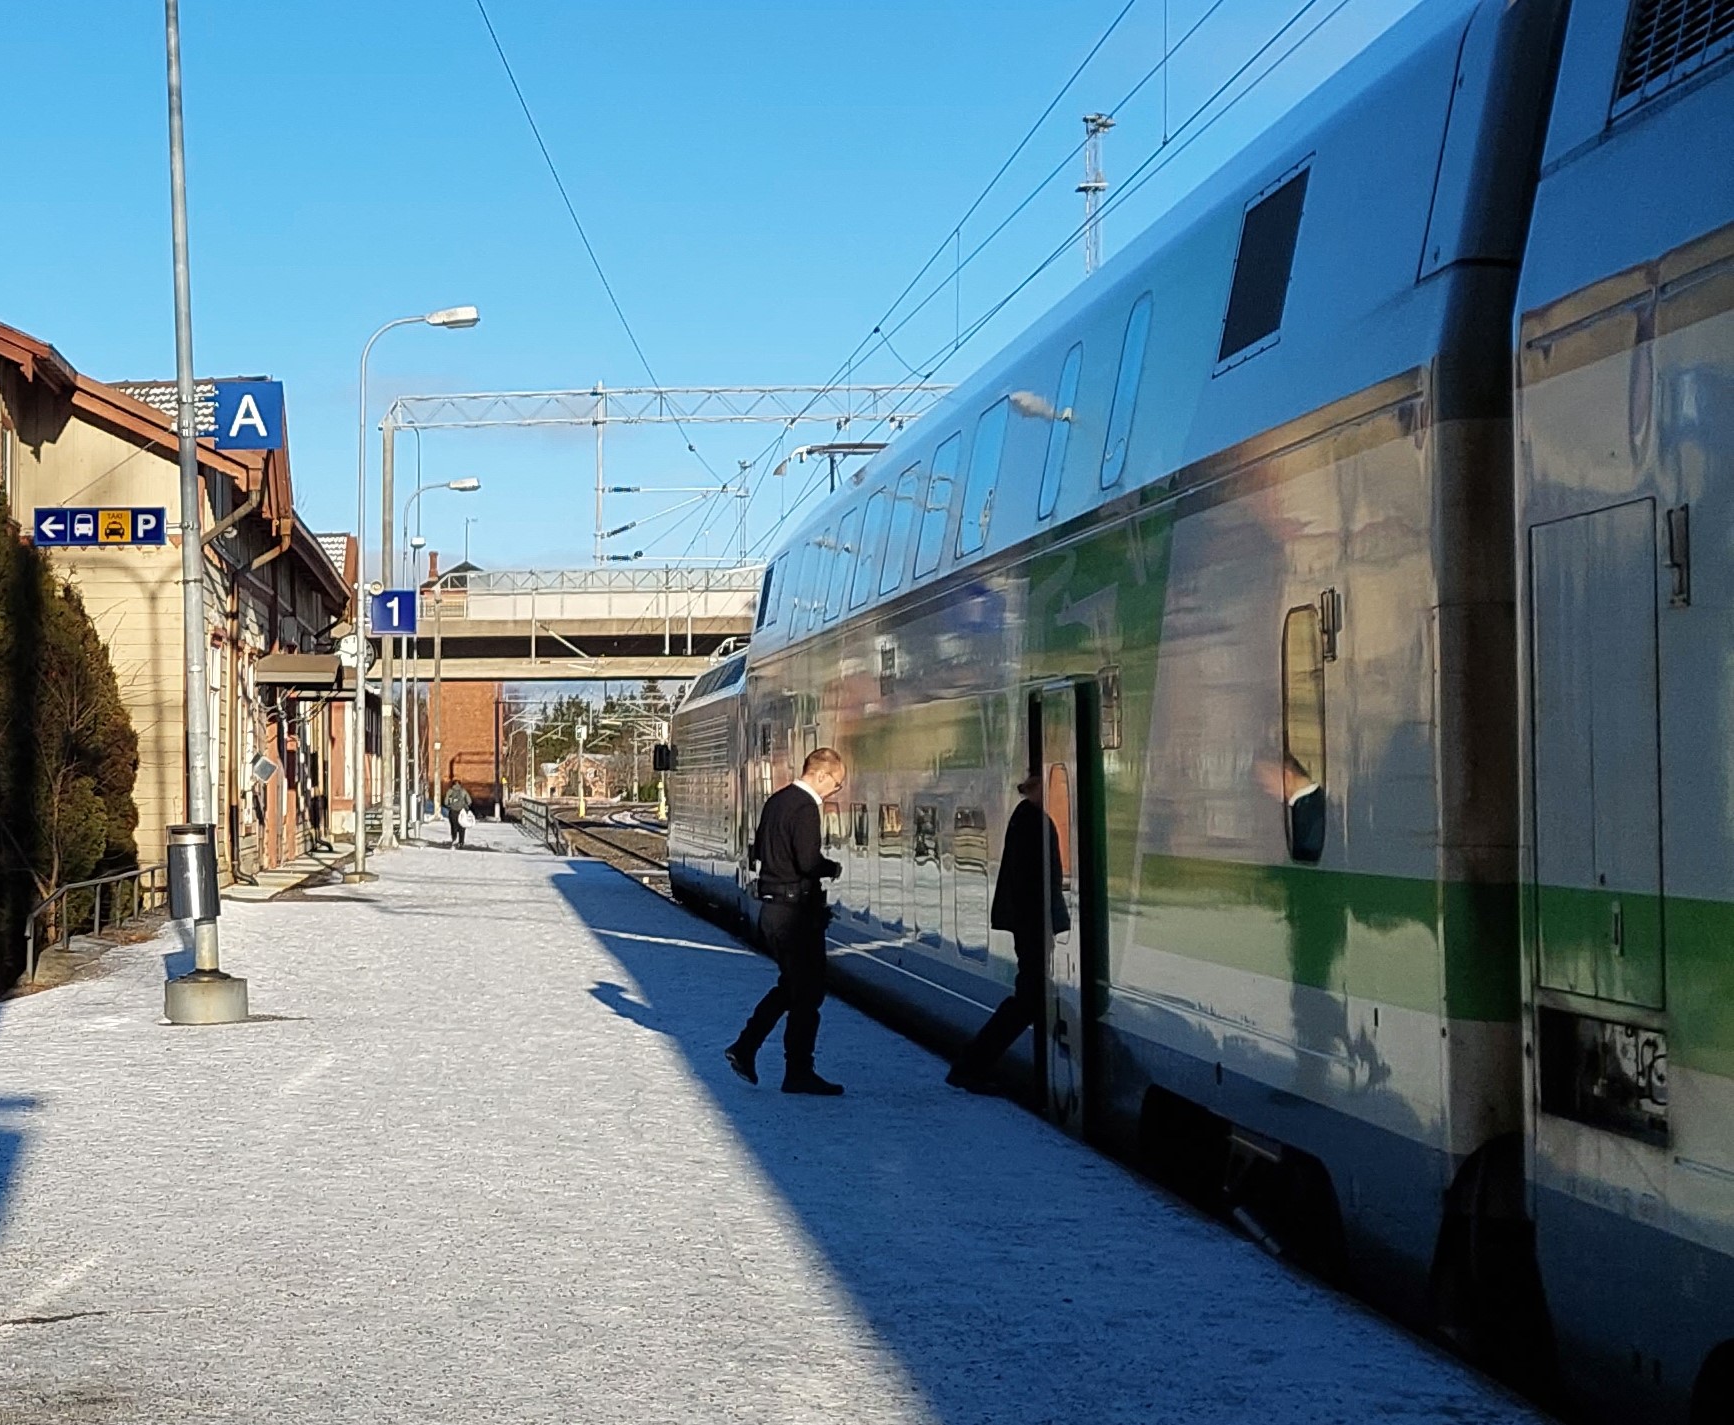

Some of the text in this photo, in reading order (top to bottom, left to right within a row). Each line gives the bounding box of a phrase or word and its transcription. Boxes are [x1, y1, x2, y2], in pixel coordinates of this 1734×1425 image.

[229, 394, 268, 437] A
[137, 513, 157, 539] P
[386, 596, 399, 627] 1
